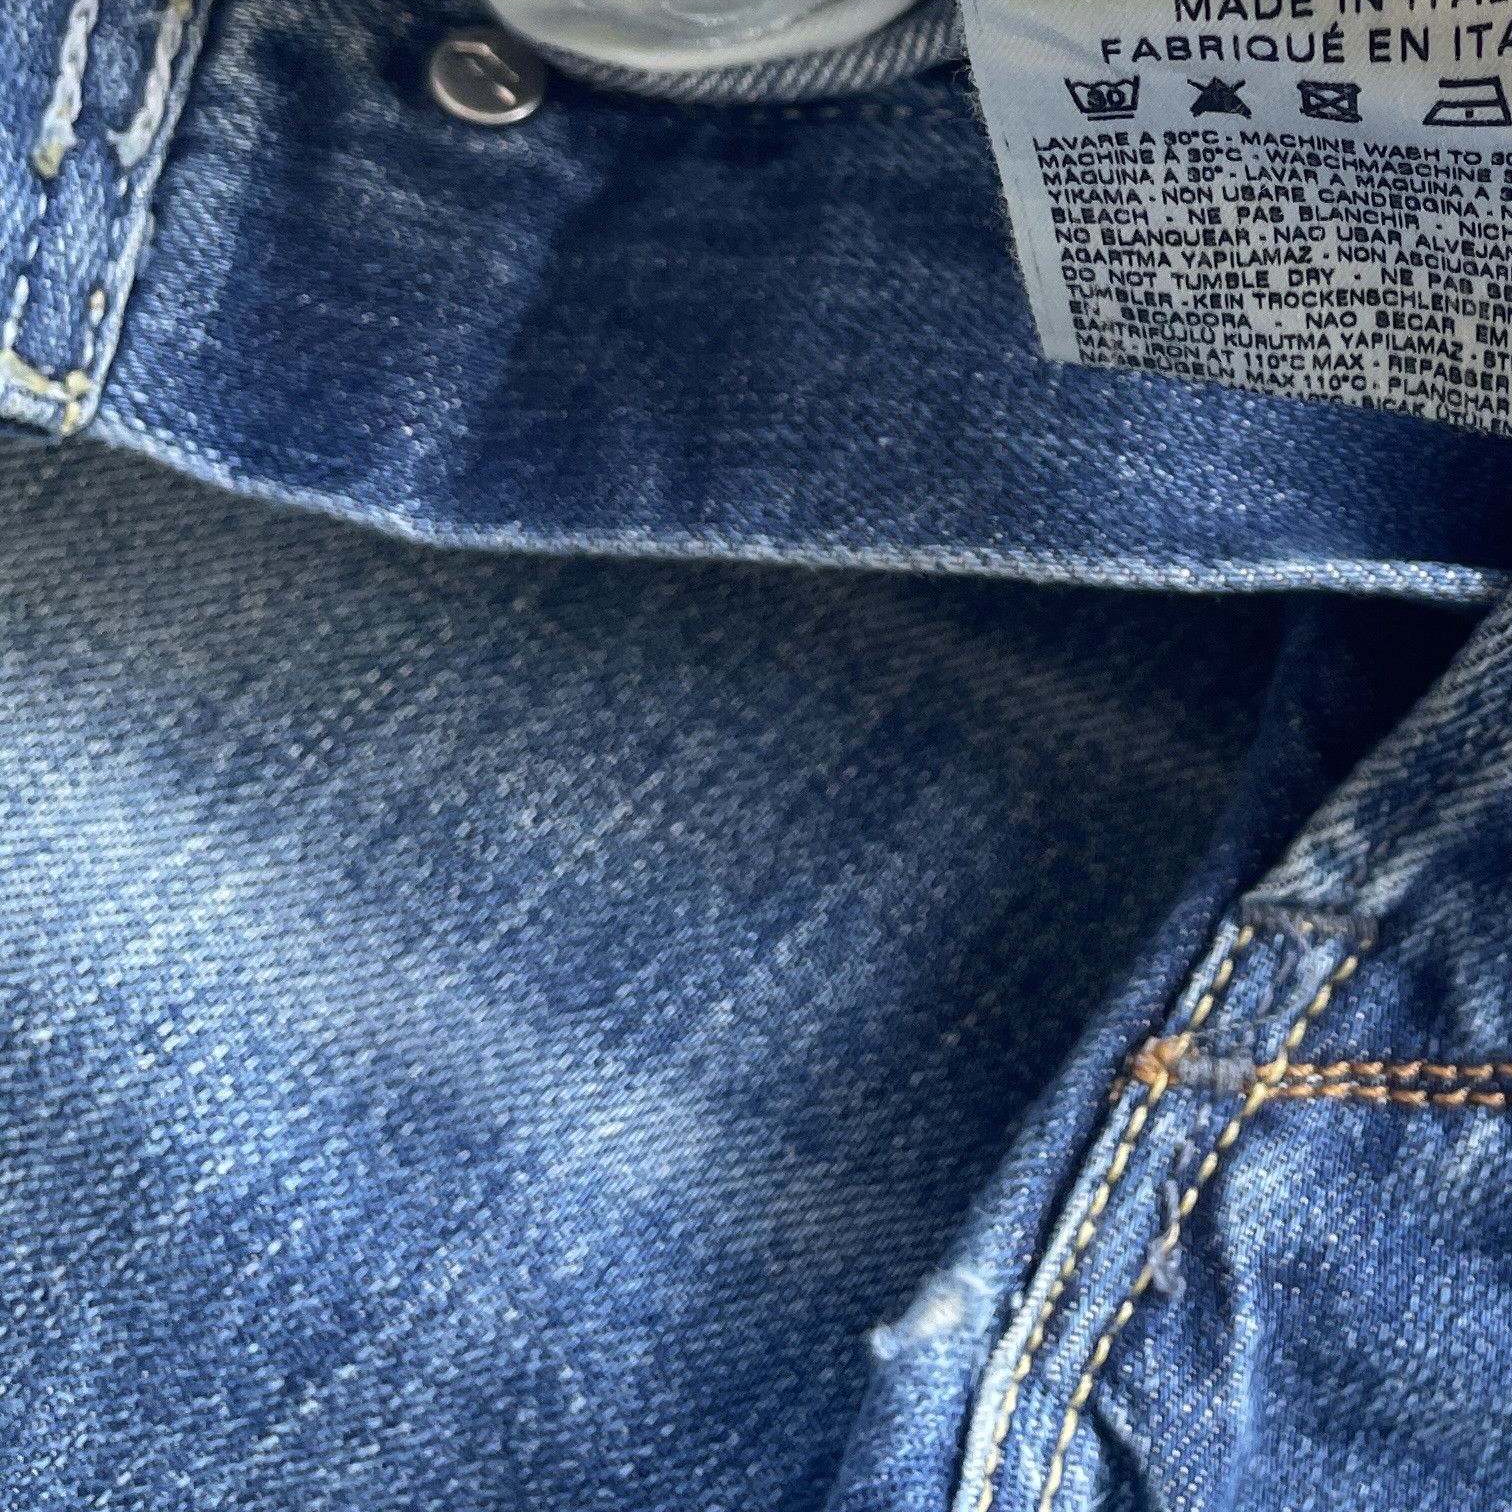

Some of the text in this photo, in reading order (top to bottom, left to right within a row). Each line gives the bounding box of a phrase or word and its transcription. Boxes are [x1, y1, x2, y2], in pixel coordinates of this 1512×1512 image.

[1101, 22, 1345, 64] FABRIQUÉ
[1369, 26, 1430, 64] EN
[1033, 131, 1130, 152] LAVARE
[1240, 131, 1357, 155] MACHINE
[1363, 142, 1440, 162] WASH
[1447, 149, 1483, 166] TO
[1038, 148, 1155, 169] MACHINE
[1266, 149, 1491, 183] WASCHMASCHINE
[1244, 165, 1319, 185] LAVAR
[1048, 187, 1143, 205] YIKAMA
[1162, 186, 1214, 205] NON
[1051, 207, 1149, 225] BLEACH
[1188, 207, 1222, 225] NE
[1237, 205, 1285, 225] PAS
[1299, 205, 1420, 231] BLANCHIR
[1054, 227, 1090, 244] NO
[1100, 227, 1251, 247] BLANQUEAR
[1336, 226, 1403, 247] USAR
[1180, 245, 1313, 269] YAPILAMAZ
[1337, 245, 1388, 264] NON
[1062, 265, 1096, 283] DO
[1108, 268, 1157, 288] NOT
[1170, 270, 1270, 290] TUMBLE
[1288, 267, 1335, 287] DRY
[1381, 267, 1414, 287] NE
[1428, 271, 1474, 295] PAS
[1066, 284, 1174, 309] TUMBLER
[1193, 292, 1244, 310] KEIN
[1120, 306, 1252, 330] SECADORA
[1375, 310, 1455, 335] SECAR
[1476, 323, 1508, 348] EM
[1223, 332, 1331, 350] KURUTMA
[1340, 330, 1463, 363] YAPILAMAZ
[1144, 340, 1200, 360] IRON
[1206, 348, 1235, 364] AT
[1312, 353, 1365, 371] MAX
[1388, 354, 1510, 395] REPASSER
[1246, 369, 1295, 388] MAX
[1389, 376, 1510, 416] PLANCHAR
